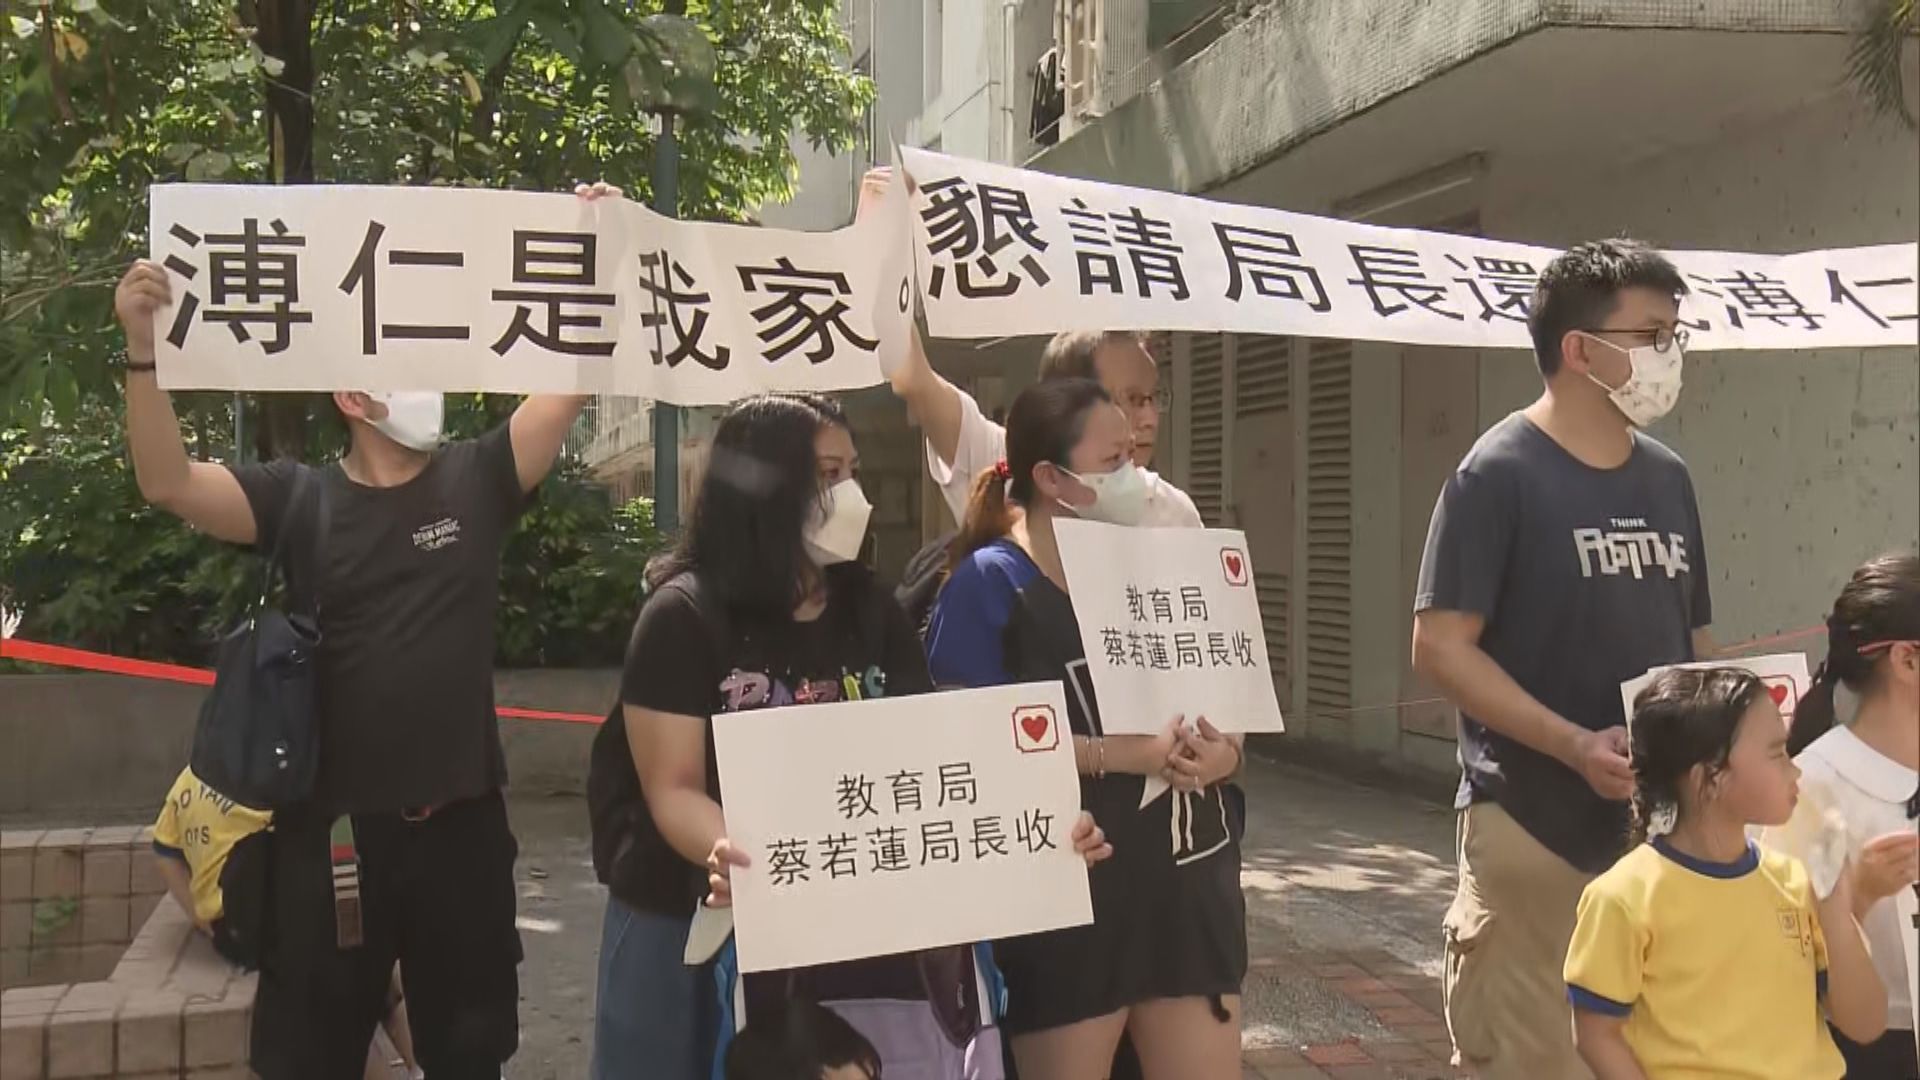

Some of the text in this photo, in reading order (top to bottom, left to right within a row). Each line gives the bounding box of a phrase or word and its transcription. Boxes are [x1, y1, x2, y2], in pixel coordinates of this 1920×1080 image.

[919, 175, 1918, 331] 懇請局長還溥仁
[1610, 517, 1648, 528] THINK
[1126, 584, 1208, 623] 教育局
[1100, 626, 1257, 670] 蔡若蓮局長收
[836, 762, 977, 819] 教育局
[766, 808, 1057, 886] 蔡若蓮局長收
